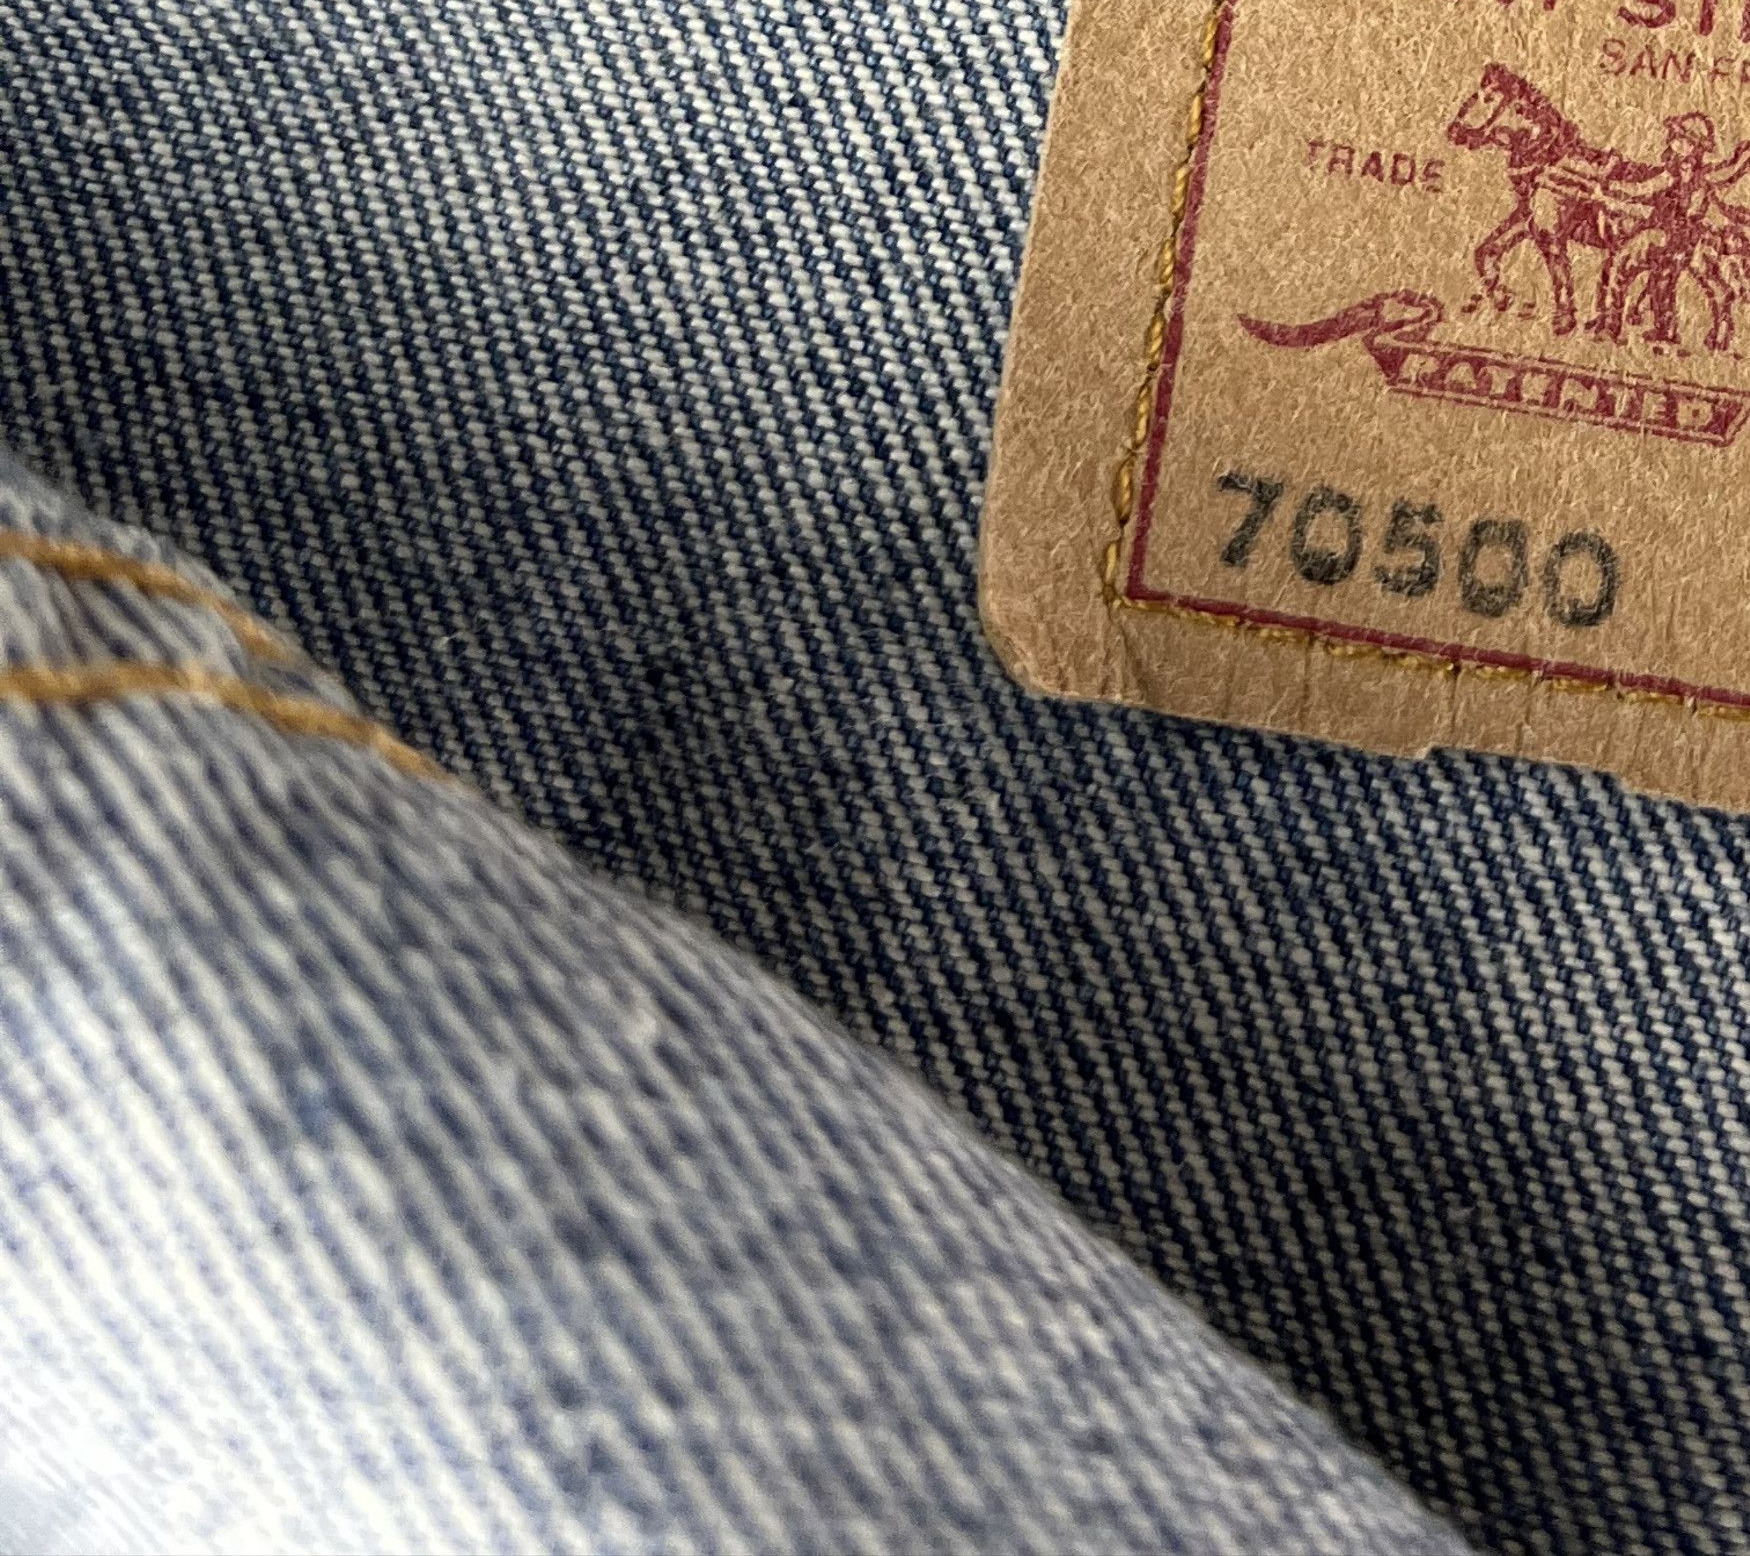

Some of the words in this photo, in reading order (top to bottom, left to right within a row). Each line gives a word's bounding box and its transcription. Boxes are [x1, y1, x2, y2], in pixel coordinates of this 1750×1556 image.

[1600, 38, 1698, 82] SAN
[1307, 140, 1446, 193] TRADE
[1217, 469, 1622, 627] 70500
